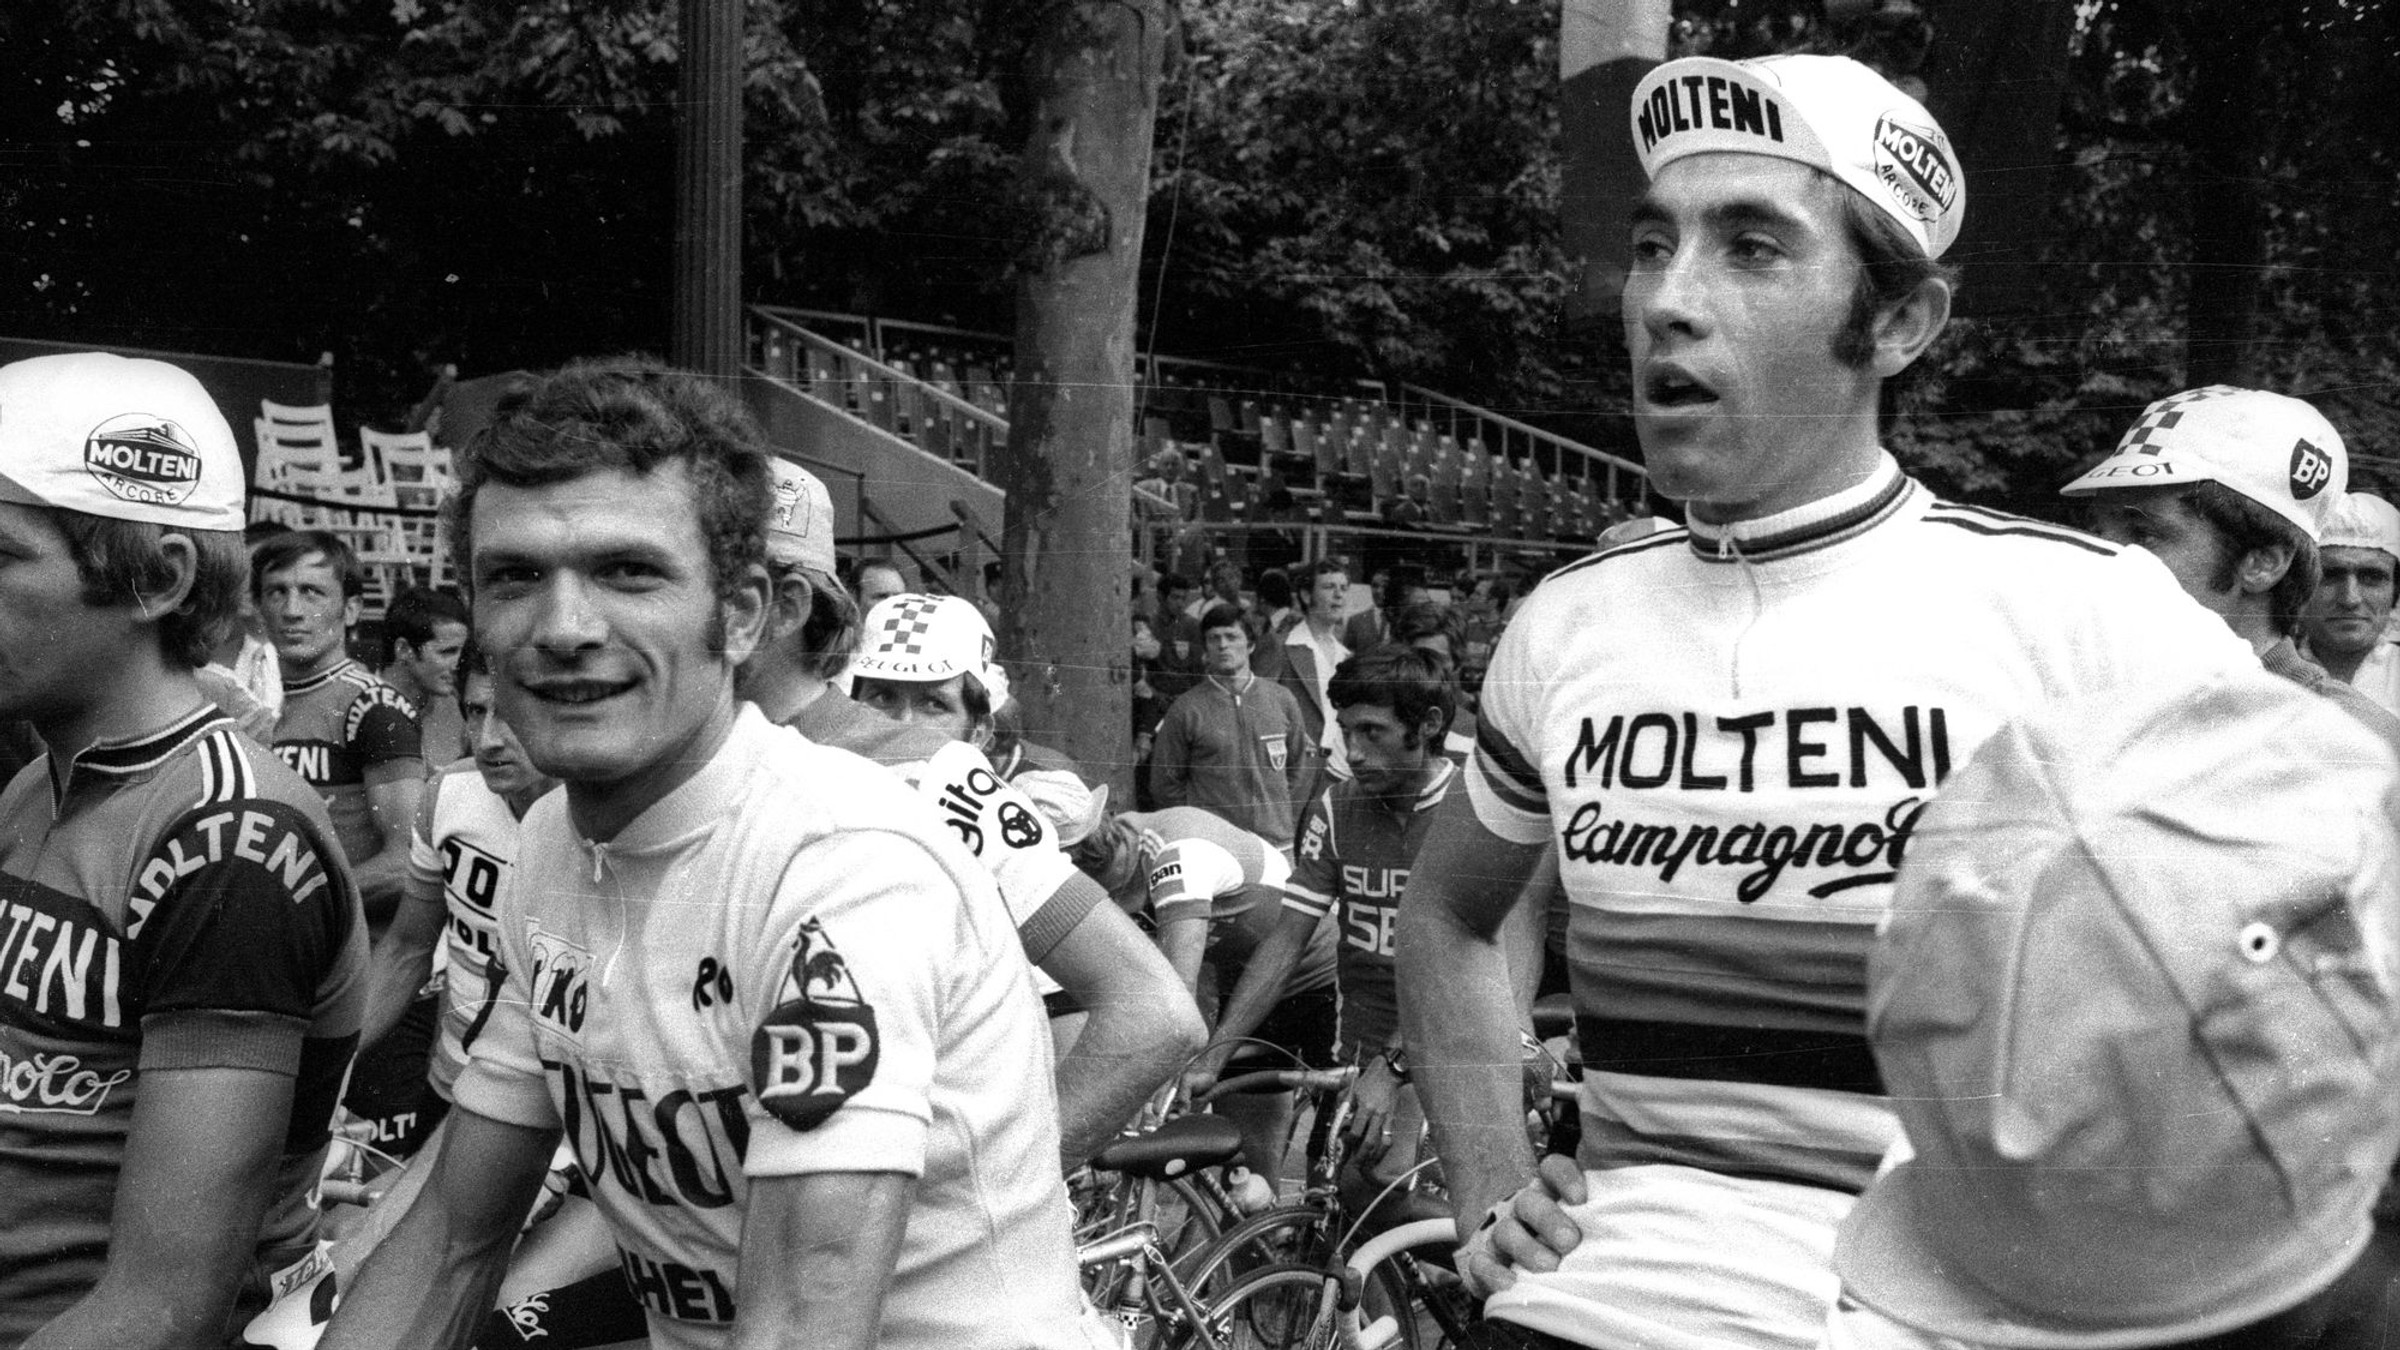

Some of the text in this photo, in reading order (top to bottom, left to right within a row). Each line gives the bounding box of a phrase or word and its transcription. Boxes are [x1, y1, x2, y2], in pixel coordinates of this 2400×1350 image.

[1637, 74, 1784, 154] MOLTENI
[1878, 120, 1956, 209] MOLTENI
[1881, 164, 1930, 214] ARCORE
[89, 439, 198, 481] MOLTENI
[101, 473, 178, 503] ARCORE
[2291, 448, 2330, 490] BP
[1564, 705, 1951, 793] MOLTENI
[1150, 863, 1182, 887] gan
[0, 899, 121, 1028] TENI
[760, 1022, 871, 1100] BP
